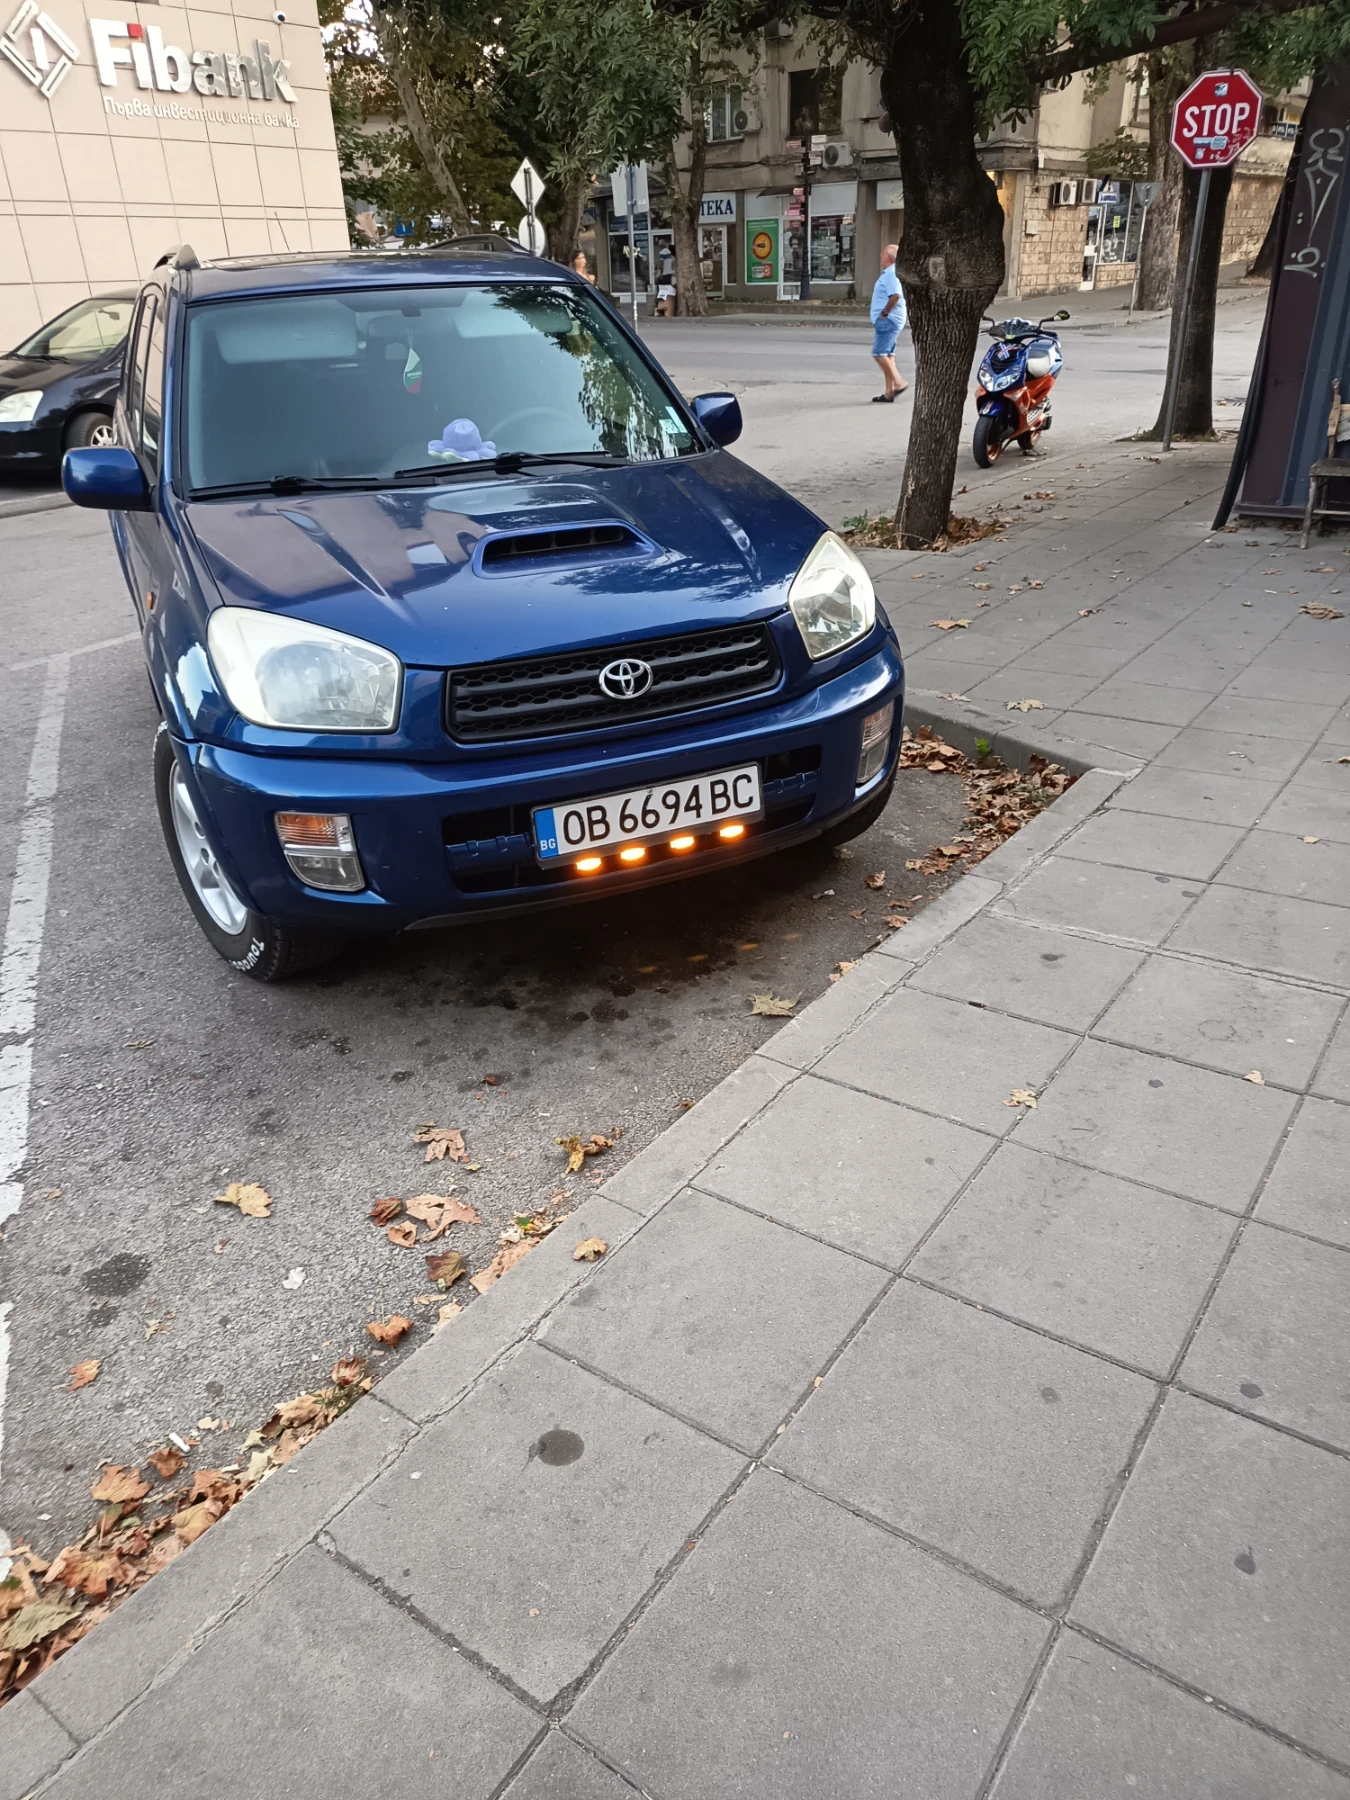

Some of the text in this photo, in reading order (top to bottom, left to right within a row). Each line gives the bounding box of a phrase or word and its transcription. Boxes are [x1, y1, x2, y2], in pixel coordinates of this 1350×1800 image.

[89, 18, 298, 102] Fibank
[102, 95, 151, 120] Първа
[1182, 102, 1251, 138] STOP
[700, 199, 734, 216] ТЕКА
[540, 838, 557, 852] BG
